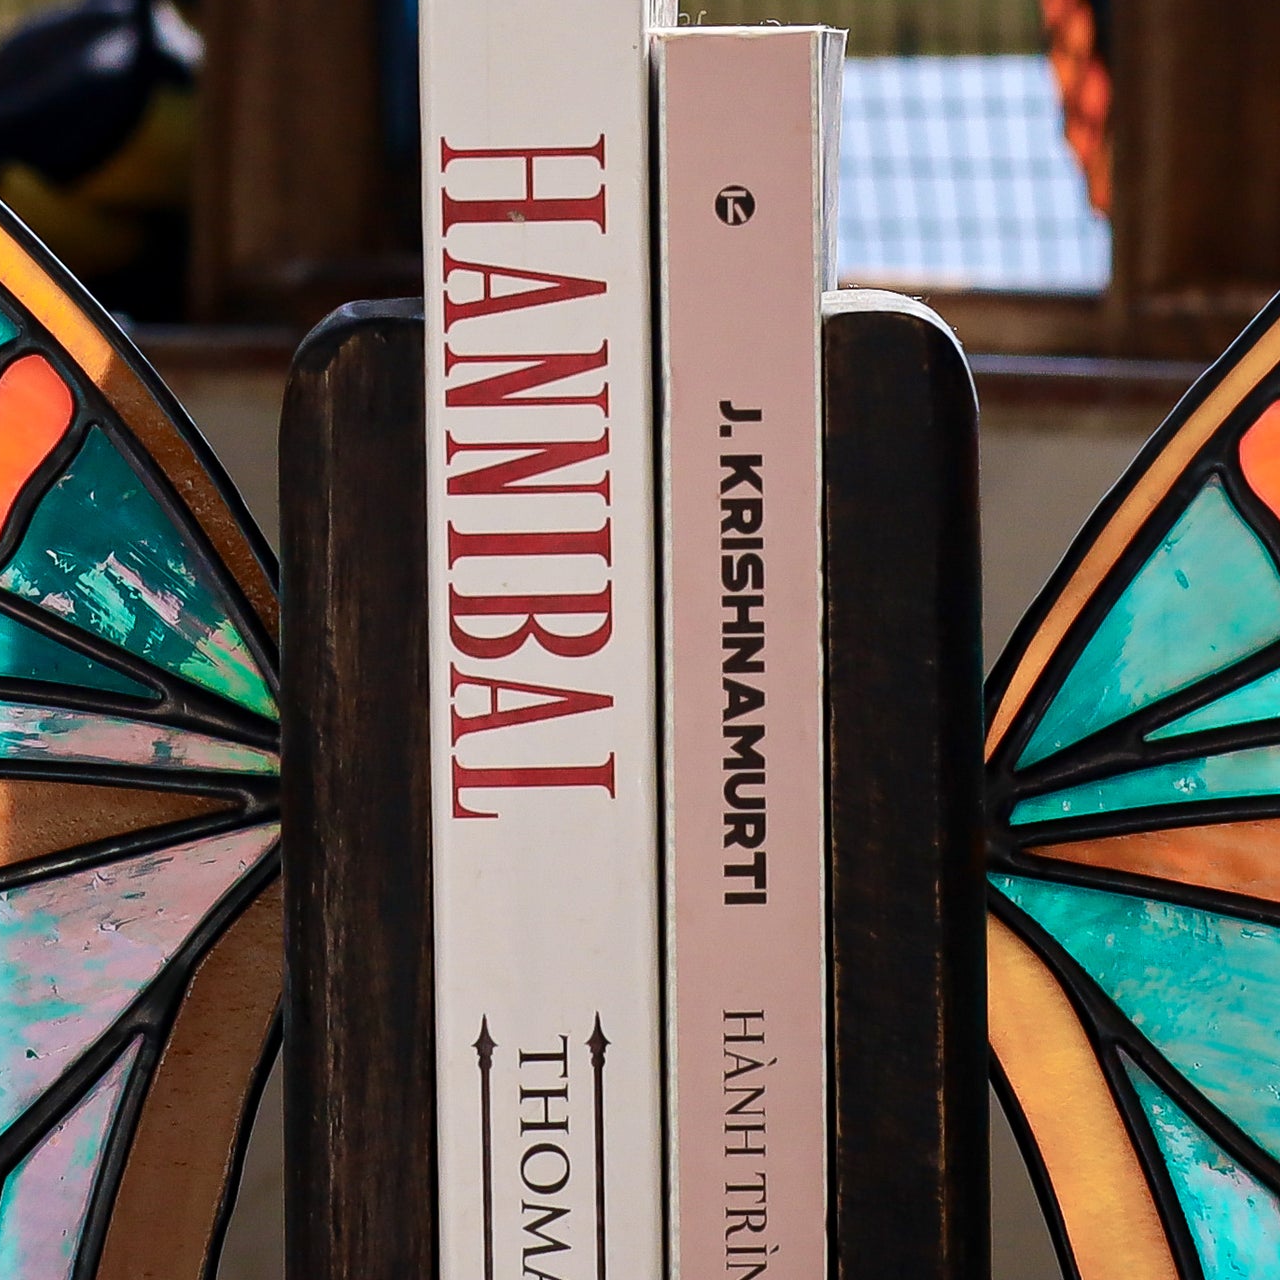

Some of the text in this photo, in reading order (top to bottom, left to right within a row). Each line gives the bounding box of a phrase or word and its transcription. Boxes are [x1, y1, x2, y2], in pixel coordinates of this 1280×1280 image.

[440, 133, 616, 820] HANNIBAL
[719, 401, 766, 905] J. KRISHNAMURTI
[723, 1010, 777, 1157] HÀNH
